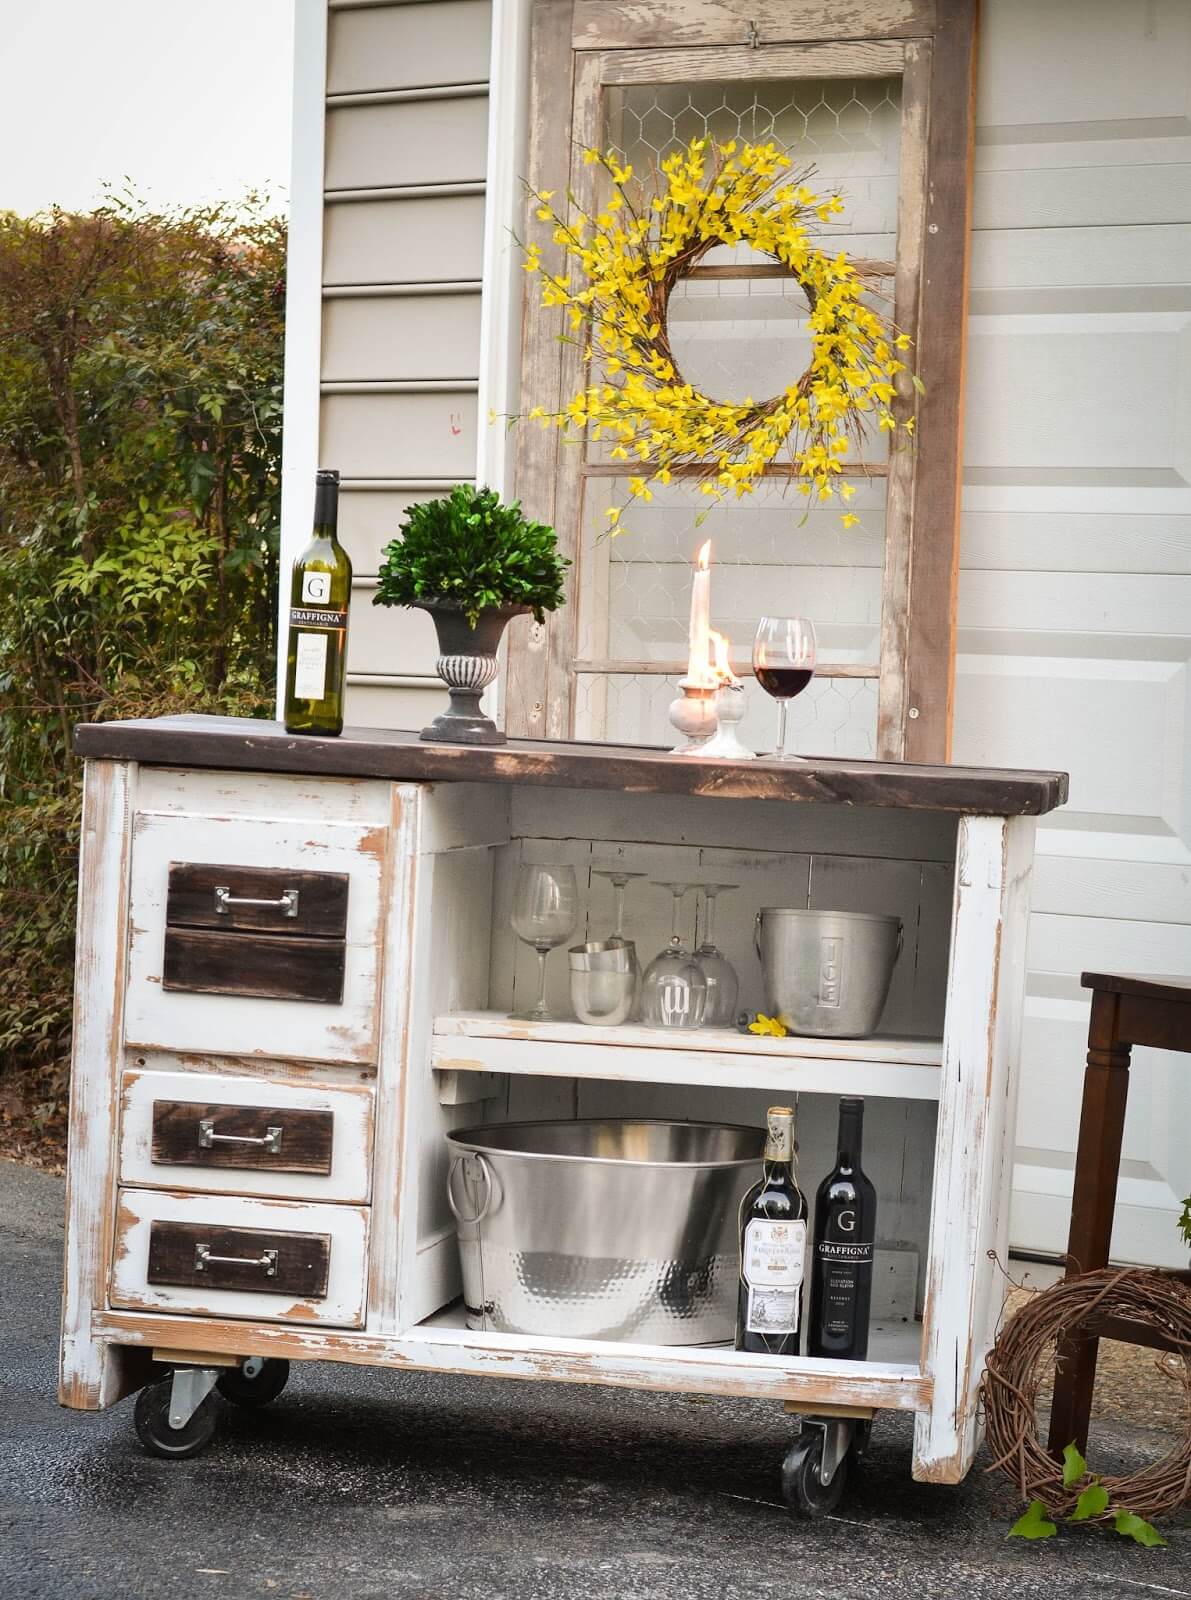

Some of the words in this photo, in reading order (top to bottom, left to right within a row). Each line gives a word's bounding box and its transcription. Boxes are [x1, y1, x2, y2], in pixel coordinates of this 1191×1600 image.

[307, 577, 324, 598] G
[291, 610, 341, 623] GRAFFIGNA
[821, 942, 838, 1002] ICE
[837, 1210, 856, 1231] G
[818, 1243, 868, 1256] GRAFFIGNA
